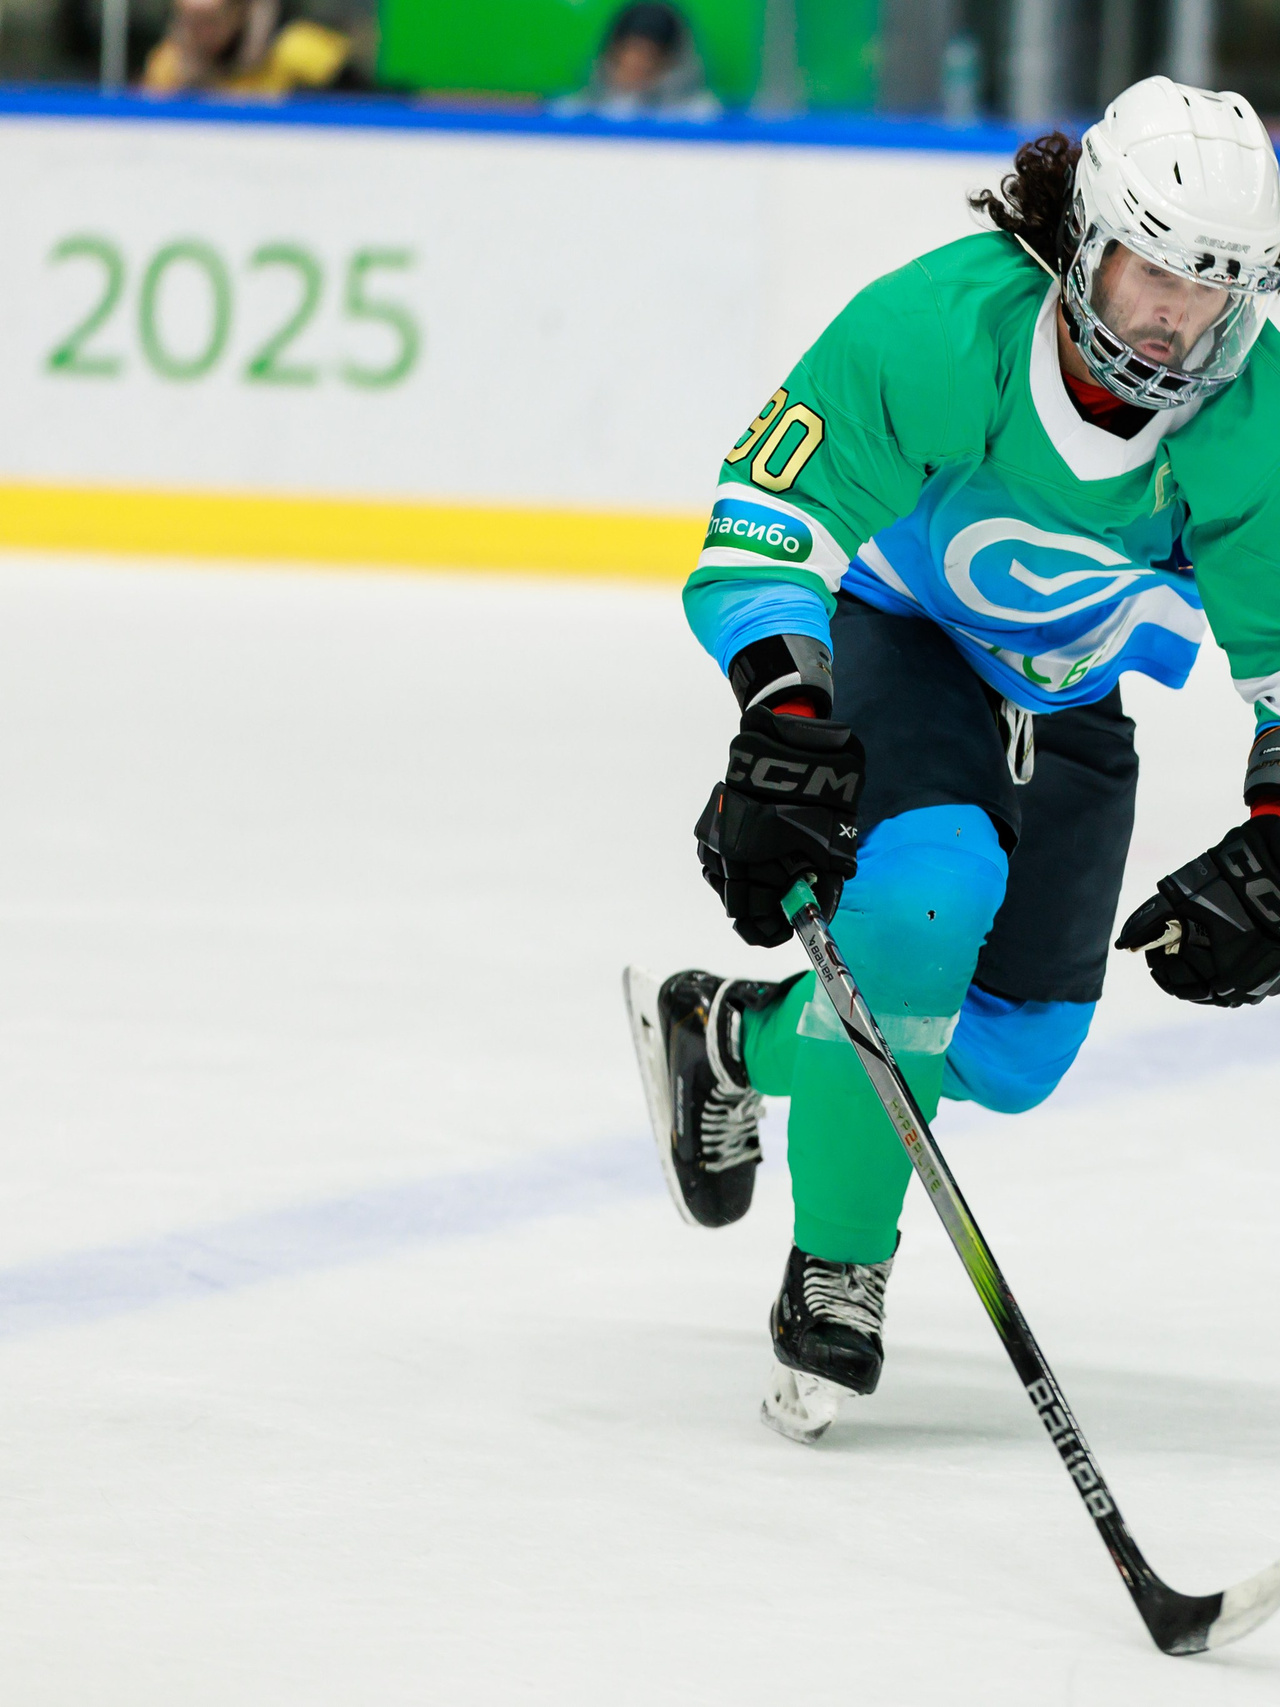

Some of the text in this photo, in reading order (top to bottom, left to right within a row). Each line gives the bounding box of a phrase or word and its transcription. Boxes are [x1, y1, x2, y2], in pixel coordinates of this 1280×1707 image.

[45, 233, 424, 390] 2025
[724, 386, 826, 494] 90
[727, 749, 859, 803] CCM
